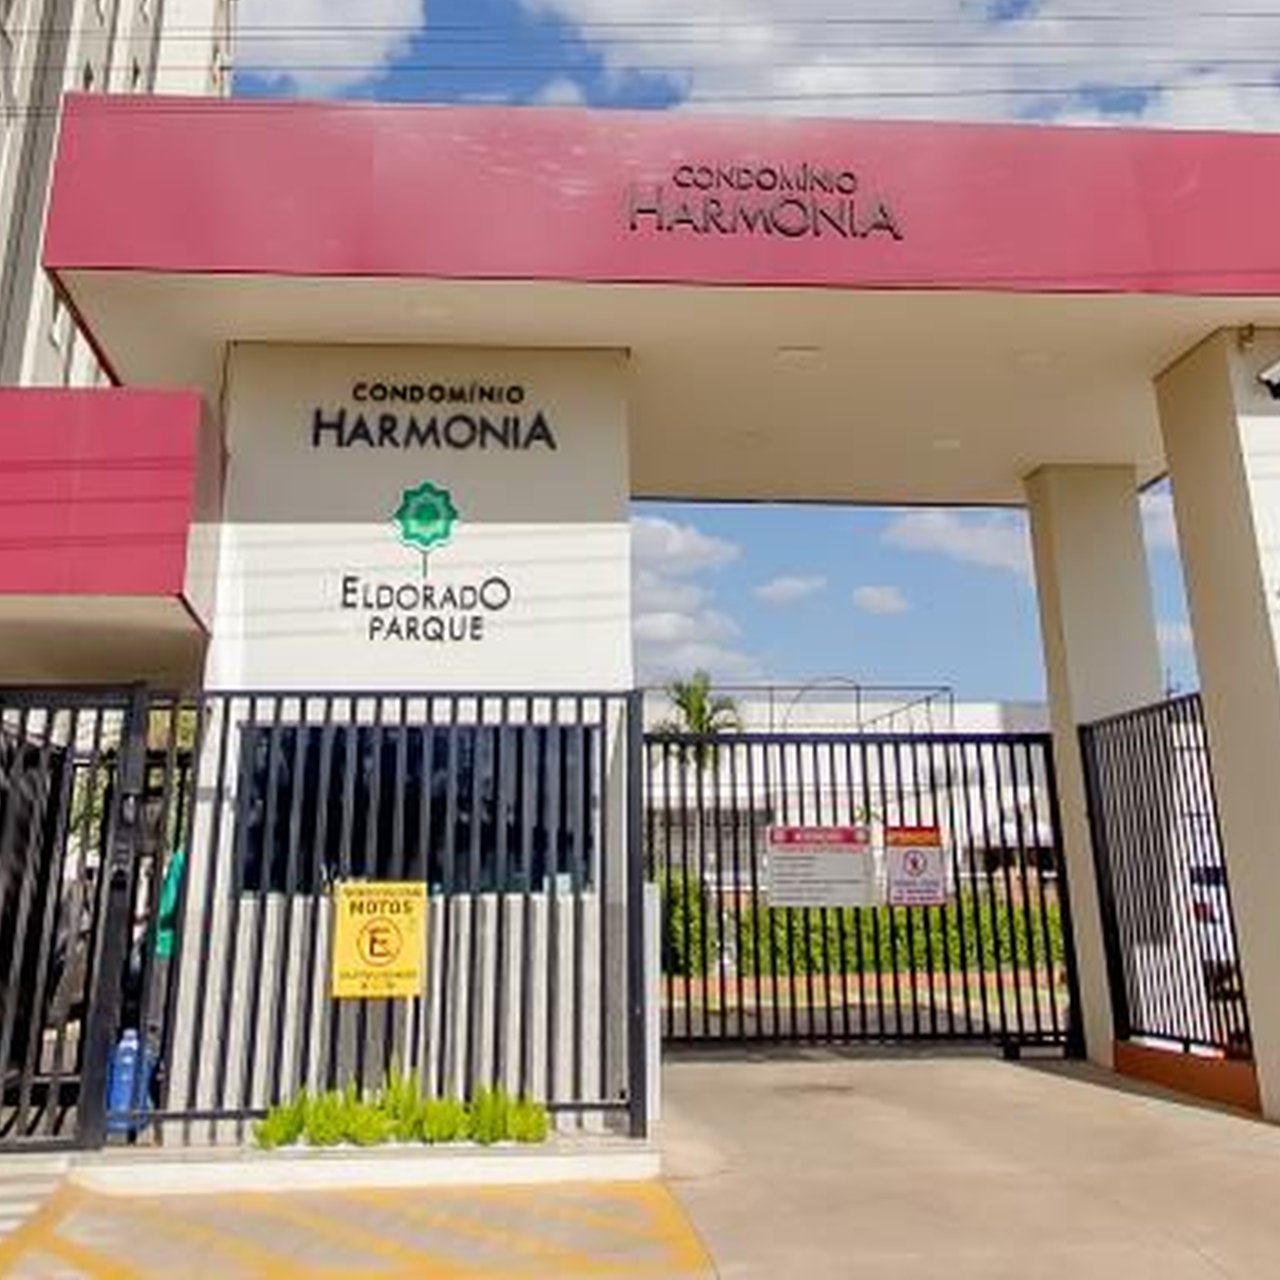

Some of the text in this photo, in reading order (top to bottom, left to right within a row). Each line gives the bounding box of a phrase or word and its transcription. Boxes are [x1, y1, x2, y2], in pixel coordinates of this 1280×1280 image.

[672, 163, 858, 195] CONDOMÍNIO
[625, 188, 904, 241] HARMONIA
[351, 381, 526, 405] CONDOMÍNIO
[312, 407, 558, 451] HARMONIA
[340, 575, 512, 611] ELDORADO
[368, 615, 484, 642] PARQUE
[349, 900, 413, 915] MOTOS
